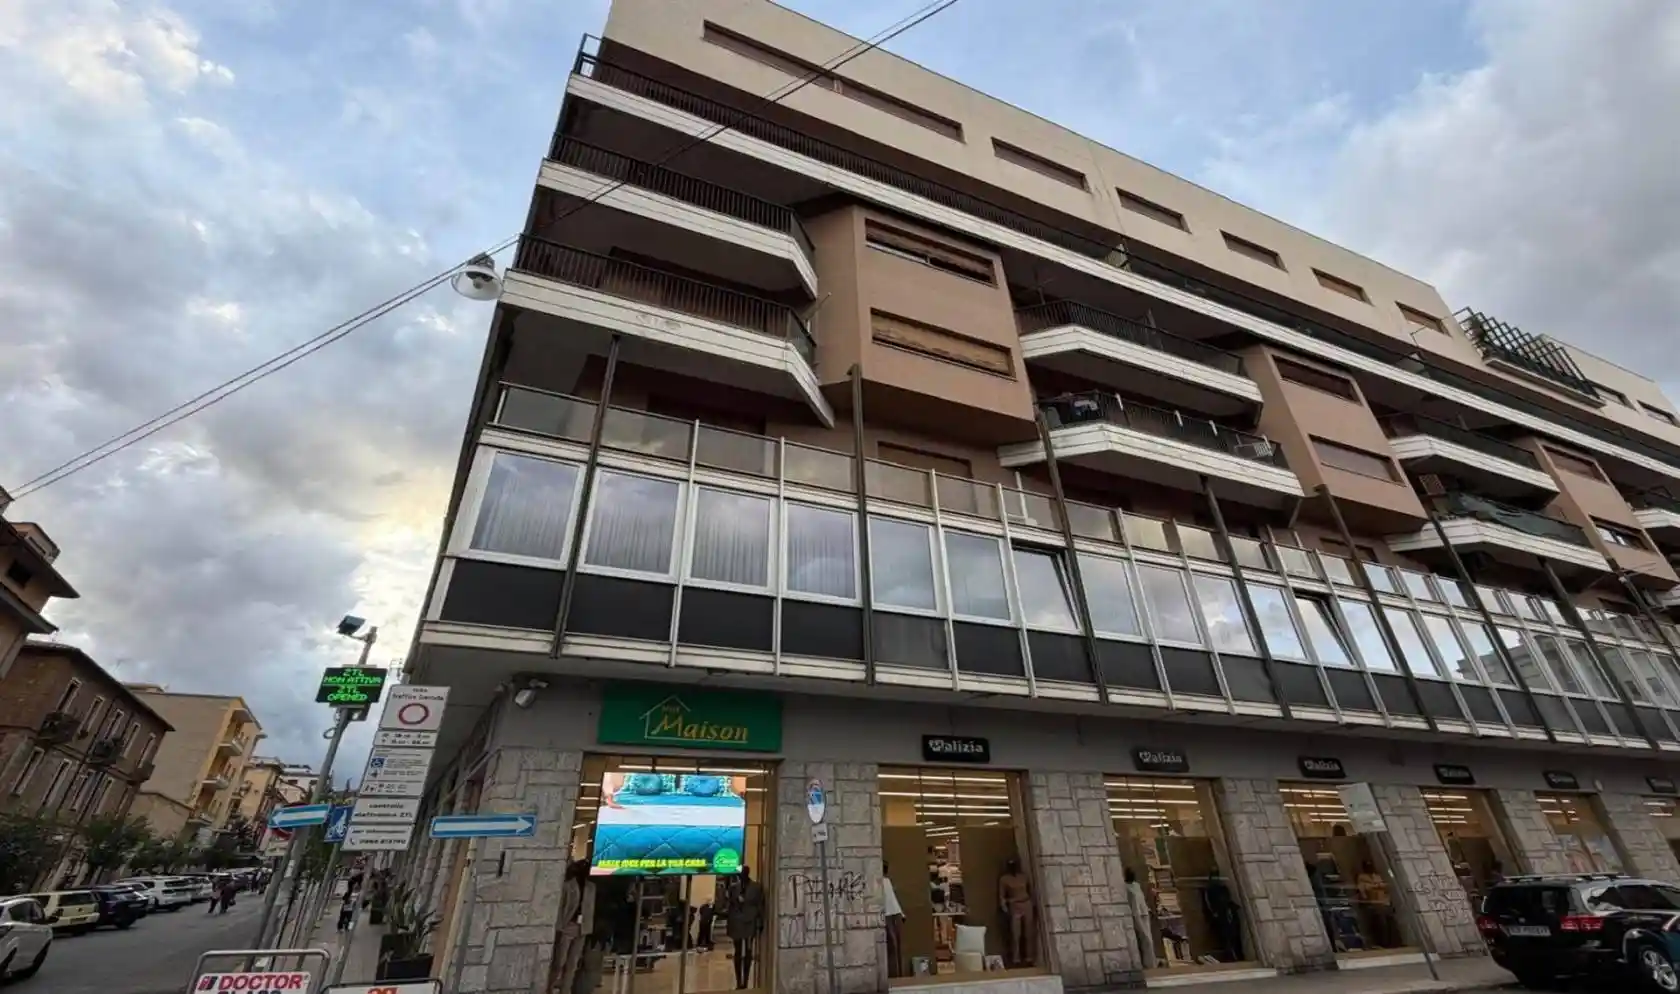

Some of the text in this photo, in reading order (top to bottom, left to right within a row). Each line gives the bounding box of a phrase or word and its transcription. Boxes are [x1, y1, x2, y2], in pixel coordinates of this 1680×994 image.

[343, 669, 364, 677] ZTL
[324, 676, 381, 684] NON ATTIVA
[337, 684, 361, 694] ZTL
[327, 693, 368, 701] OPENED
[652, 714, 748, 740] Maison
[640, 859, 656, 868] PER
[656, 859, 667, 868] LA
[218, 974, 303, 991] DOCTOR
